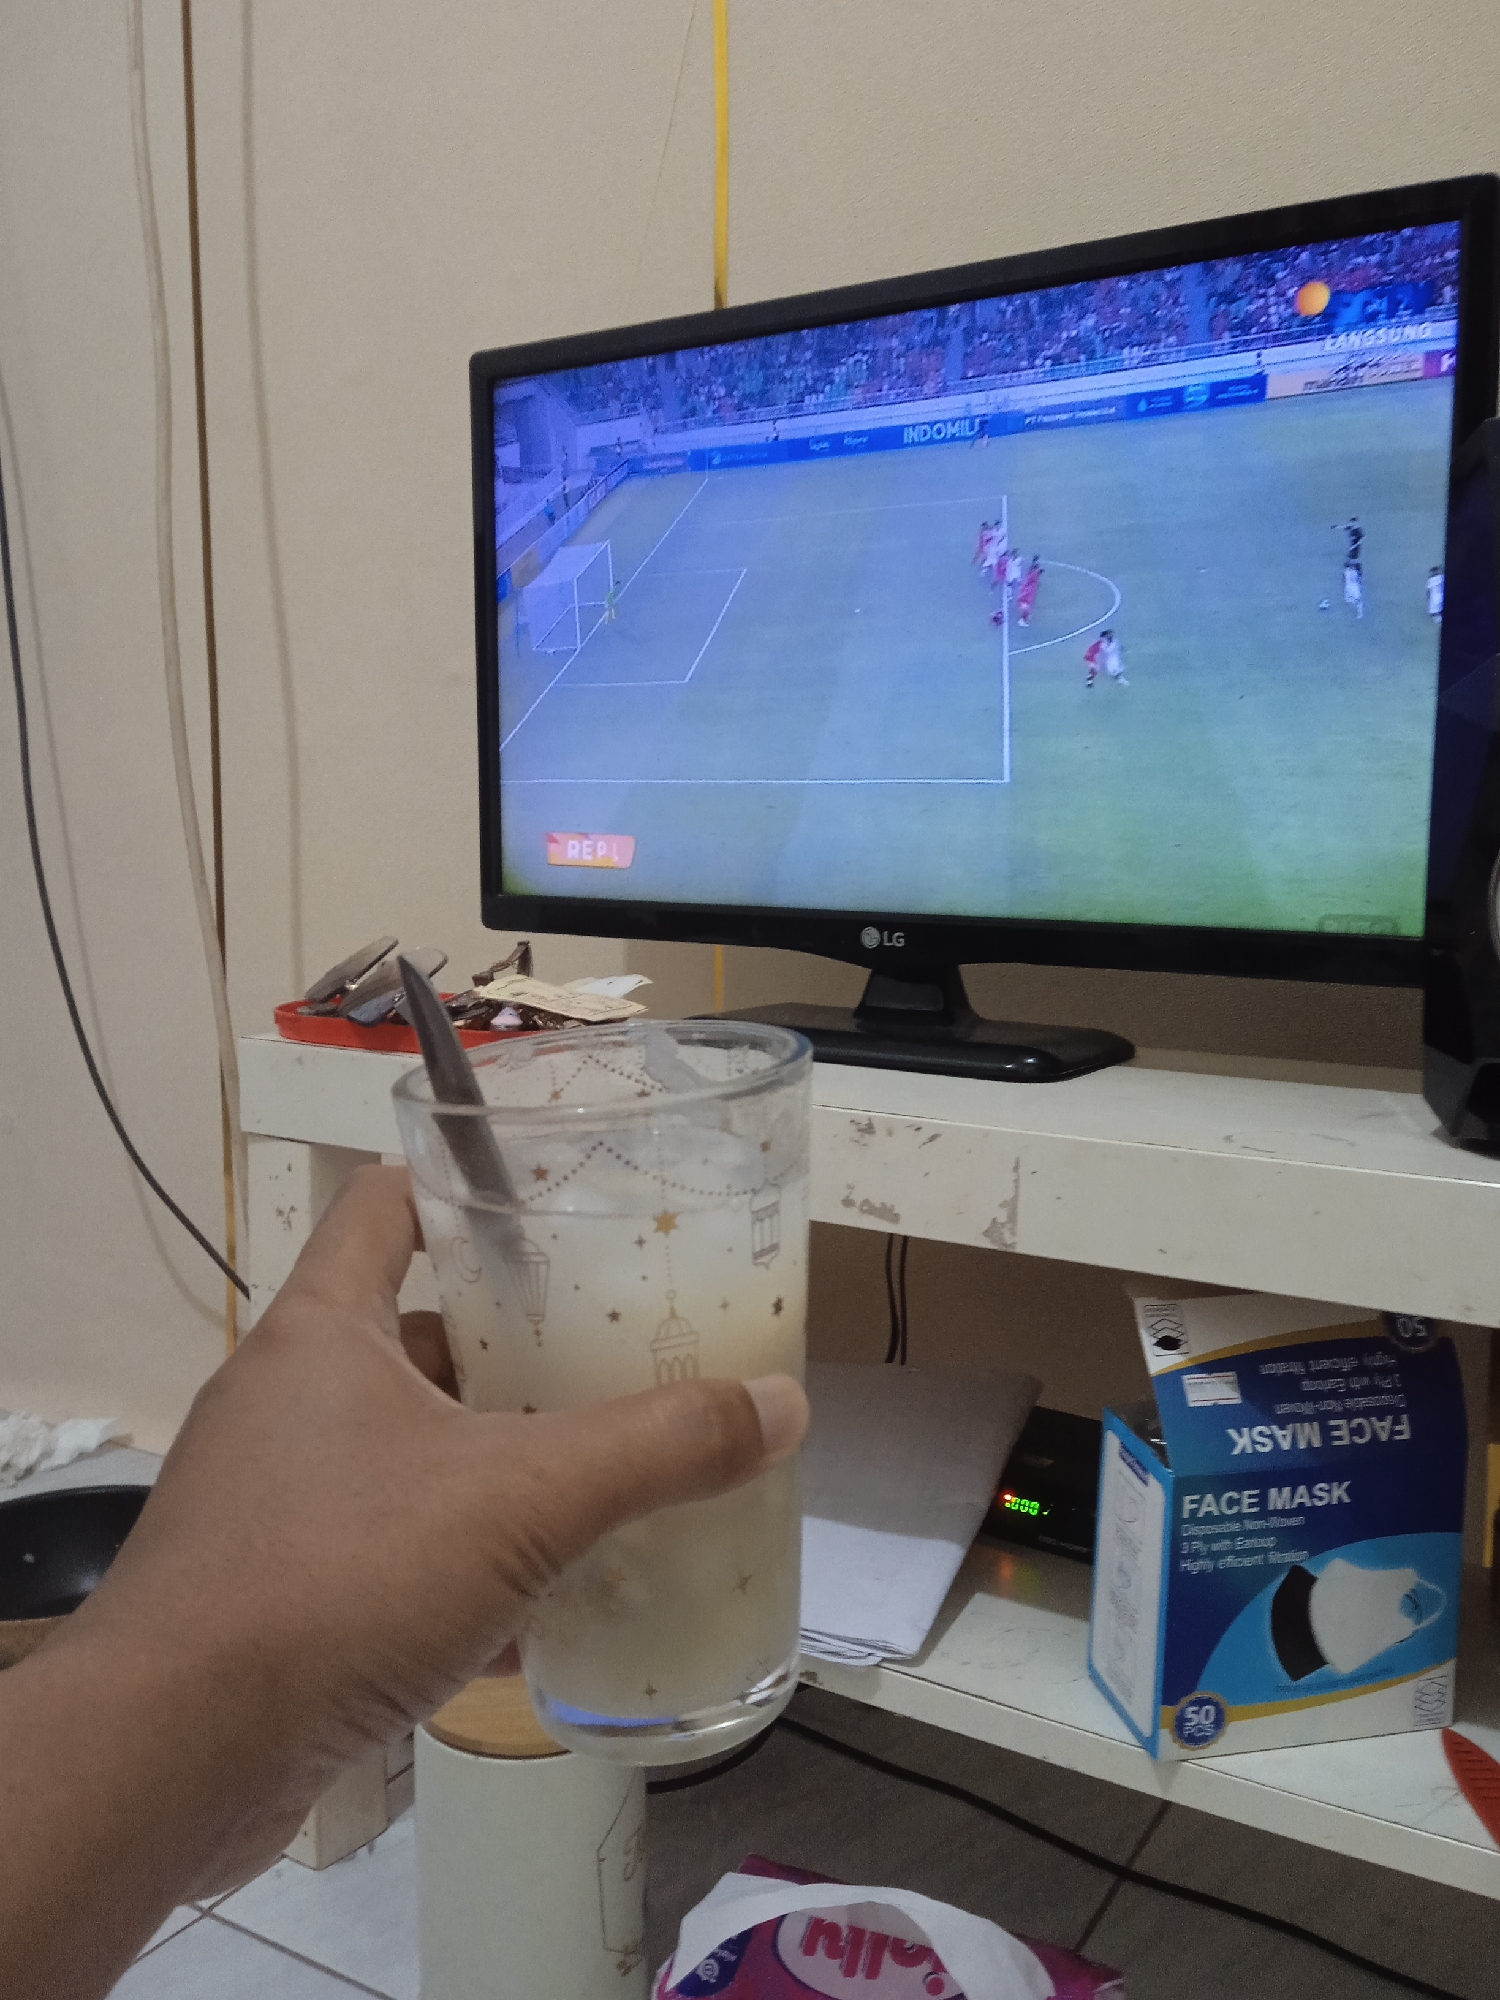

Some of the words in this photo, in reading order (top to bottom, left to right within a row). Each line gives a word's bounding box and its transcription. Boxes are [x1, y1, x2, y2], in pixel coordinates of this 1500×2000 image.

[883, 930, 905, 947] LG
[1226, 1421, 1323, 1455] MASK
[1328, 1414, 1411, 1446] FACE
[1182, 1489, 1260, 1518] FACE
[1268, 1481, 1351, 1510] MASK
[1184, 1705, 1216, 1726] 50
[1183, 1724, 1214, 1738] PCS
